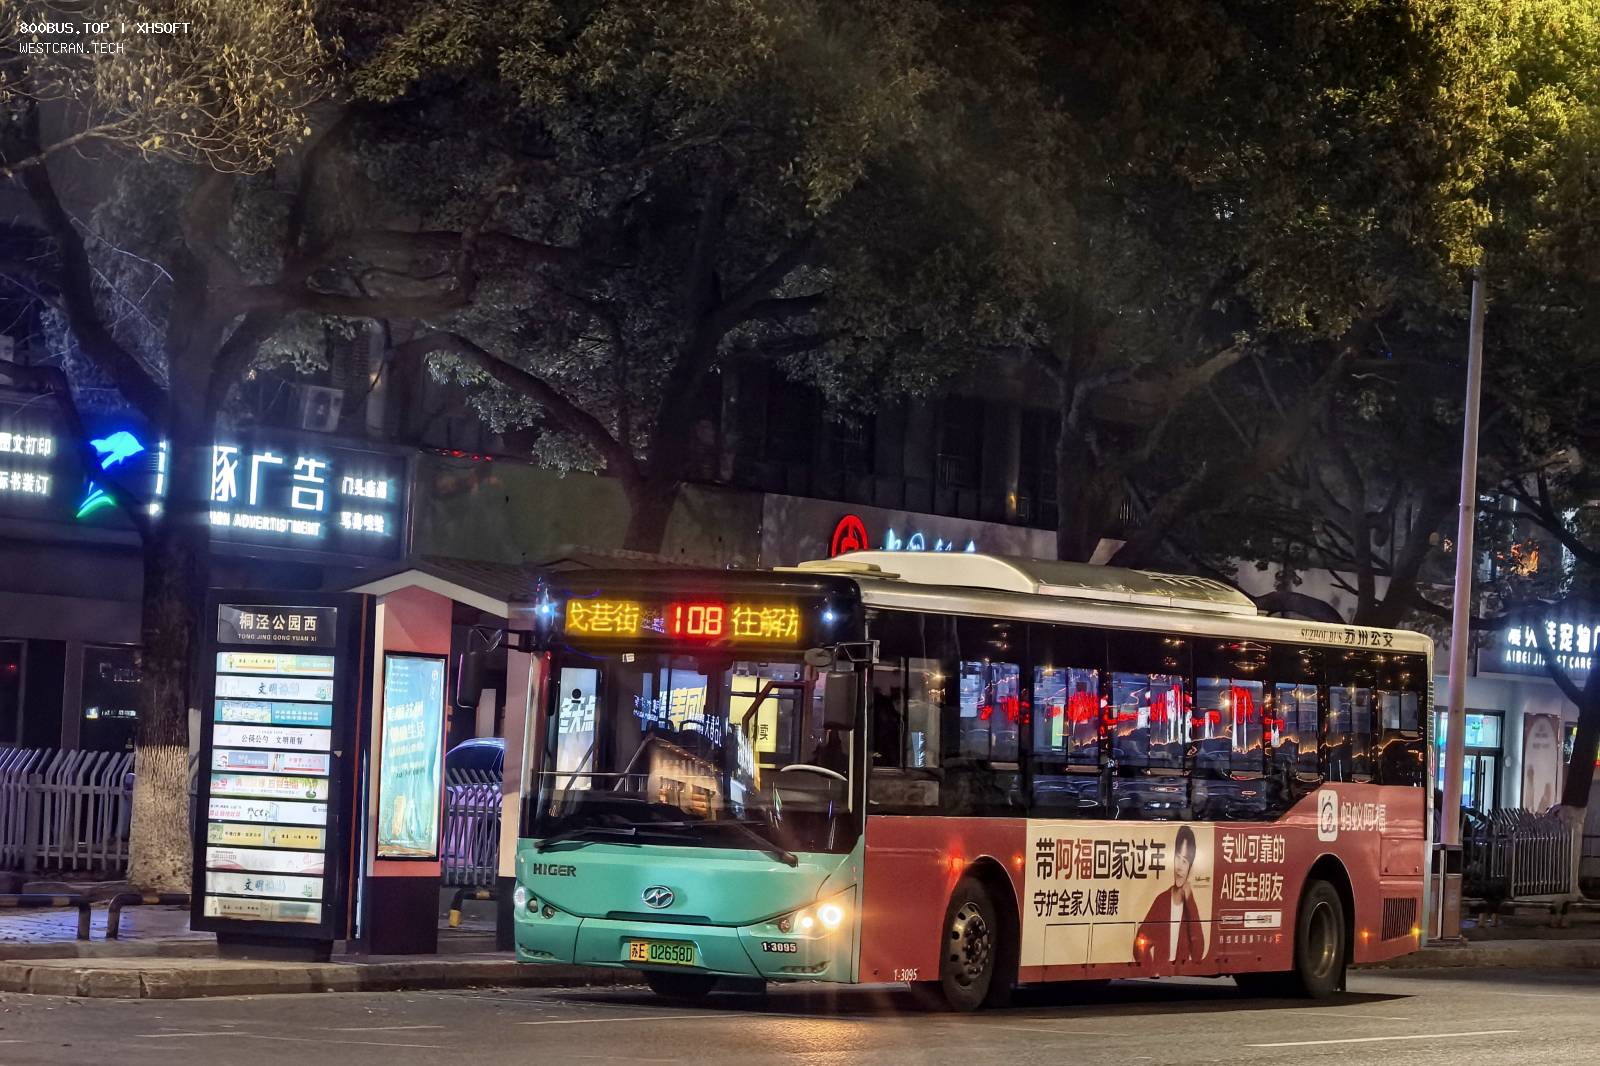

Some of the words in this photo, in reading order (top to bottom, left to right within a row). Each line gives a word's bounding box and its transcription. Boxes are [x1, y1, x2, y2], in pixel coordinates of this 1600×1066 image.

[239, 612, 318, 631] 桐泾公园西
[568, 602, 639, 633] 戈巷街
[675, 606, 723, 635] 108
[1344, 628, 1394, 648] 苏州公交
[1340, 801, 1386, 833] 蚂蚁阿福
[1036, 838, 1166, 880] 带阿福回家过年
[1221, 833, 1285, 864] 专业可靠的
[533, 862, 577, 877] HIGER
[1220, 872, 1284, 902] AI医生朋友
[1033, 888, 1120, 917] 守护全家人健康
[894, 968, 918, 981] 1-3095
